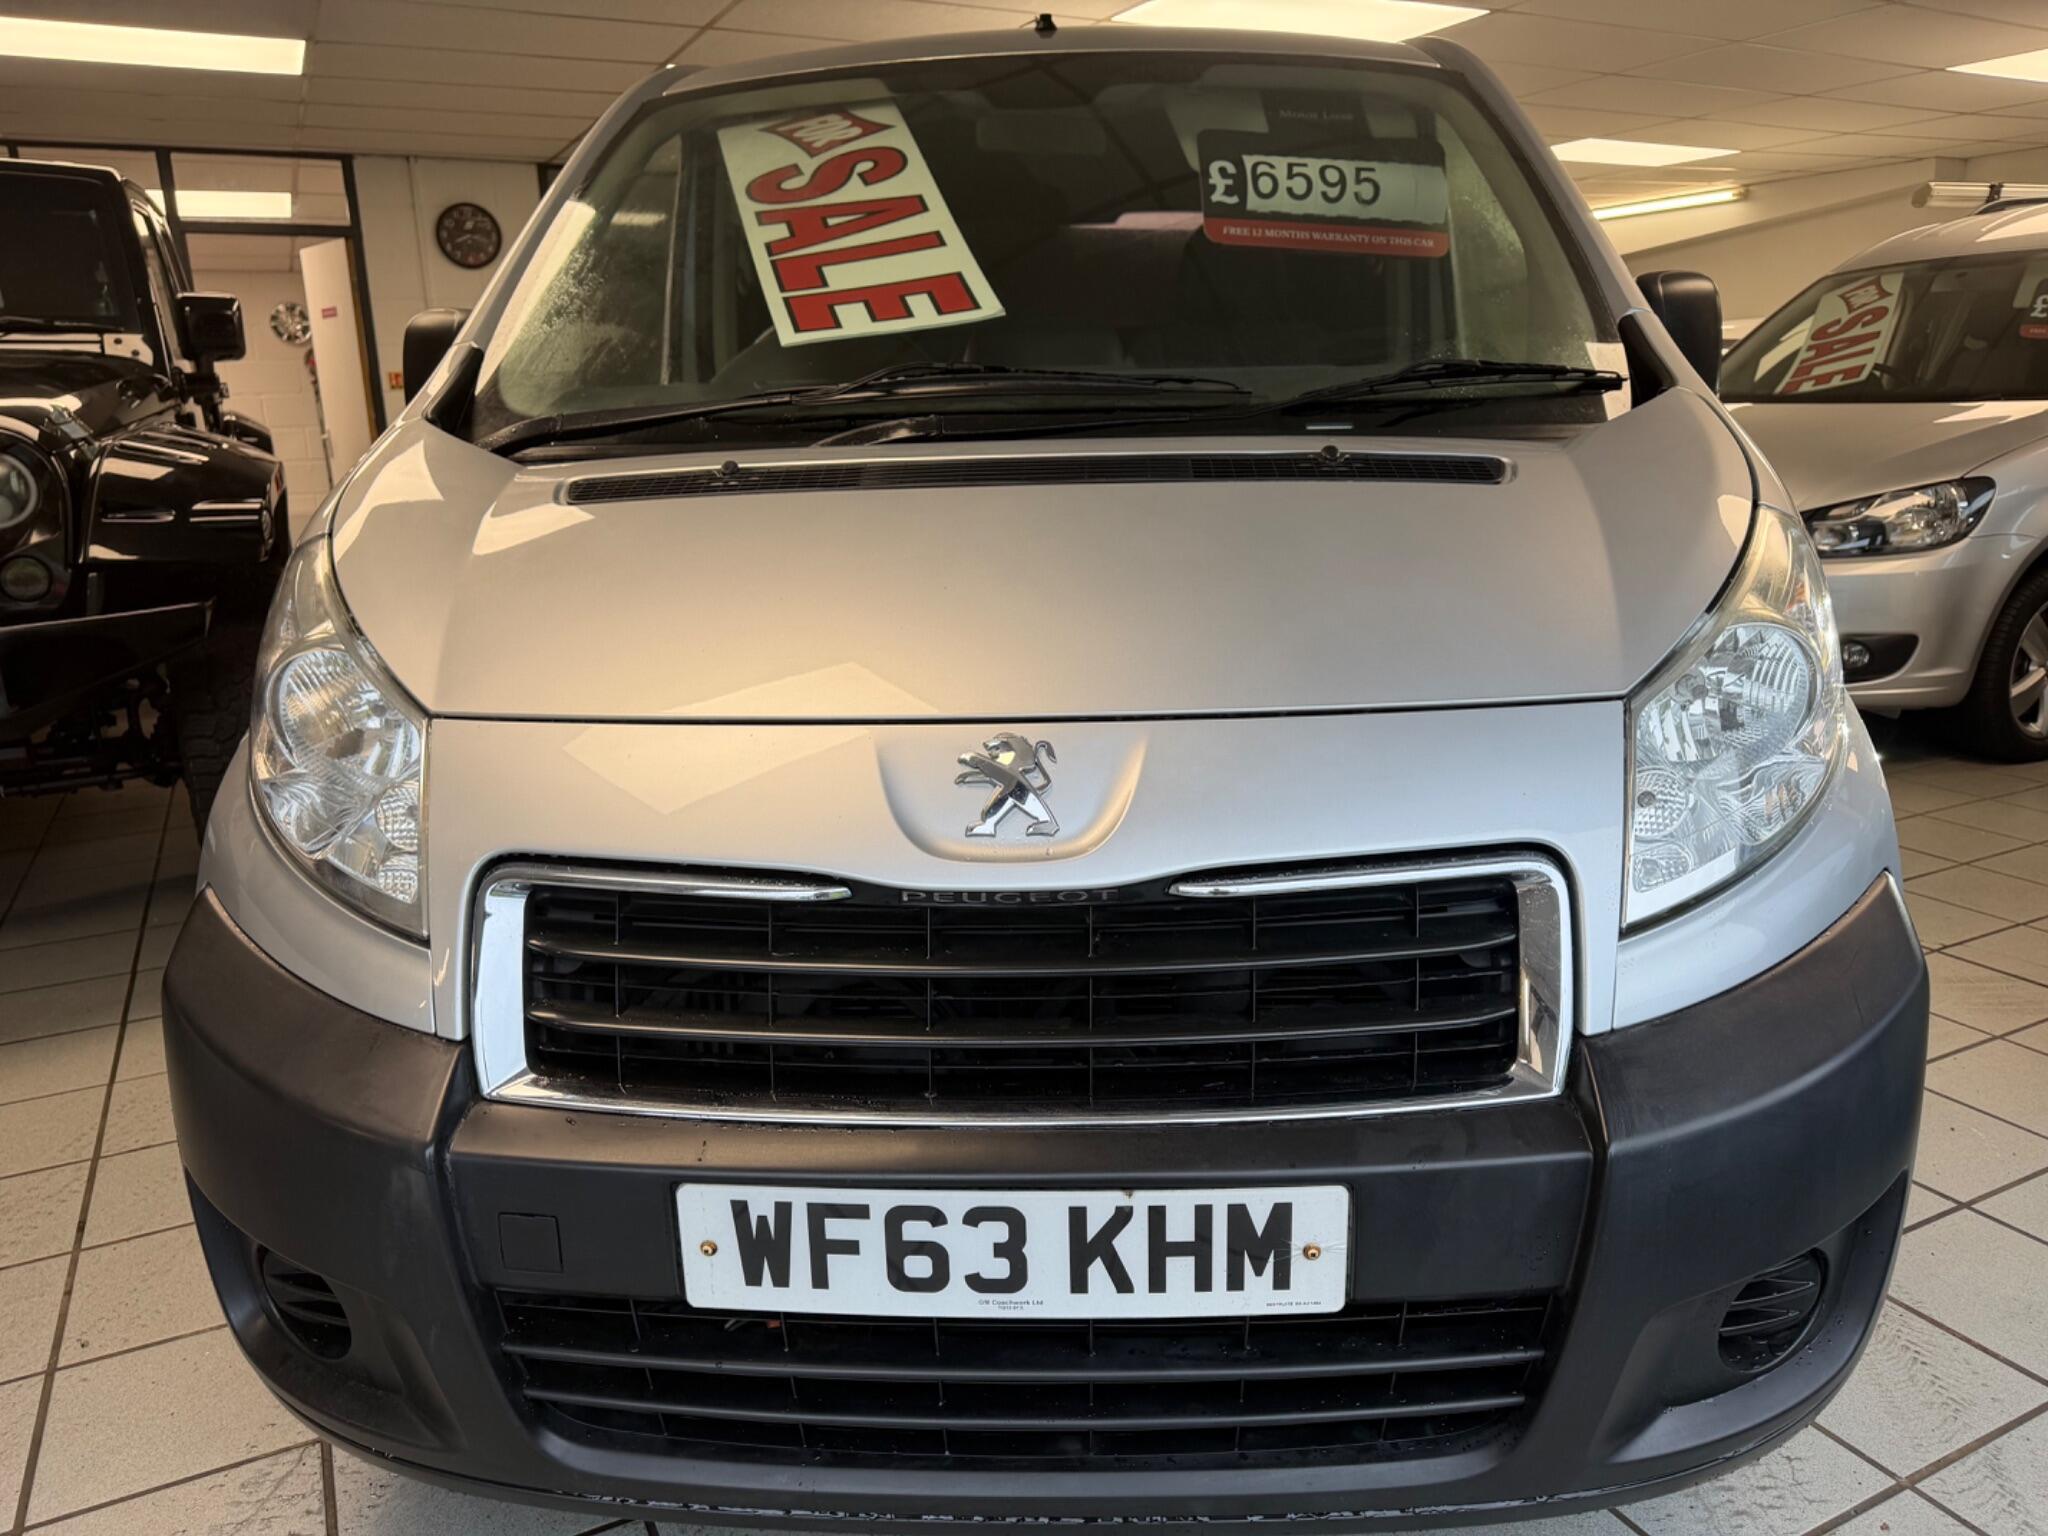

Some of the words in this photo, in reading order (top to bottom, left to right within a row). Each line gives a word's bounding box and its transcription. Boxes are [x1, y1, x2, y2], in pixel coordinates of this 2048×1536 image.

[777, 114, 863, 148] FOR
[745, 146, 981, 334] SALE
[1222, 226, 1250, 237] FREE
[1252, 228, 1264, 238] 12
[1264, 229, 1310, 241] MONTHS
[1311, 232, 1370, 245] WARRANTY
[1372, 235, 1388, 245] ON
[1389, 236, 1413, 247] THIS
[1414, 238, 1436, 248] CAR
[1782, 305, 1889, 394] SALE
[901, 889, 1121, 904] PEUGEOT
[728, 1199, 1029, 1295] WF63
[1068, 1201, 1295, 1295] KHM
